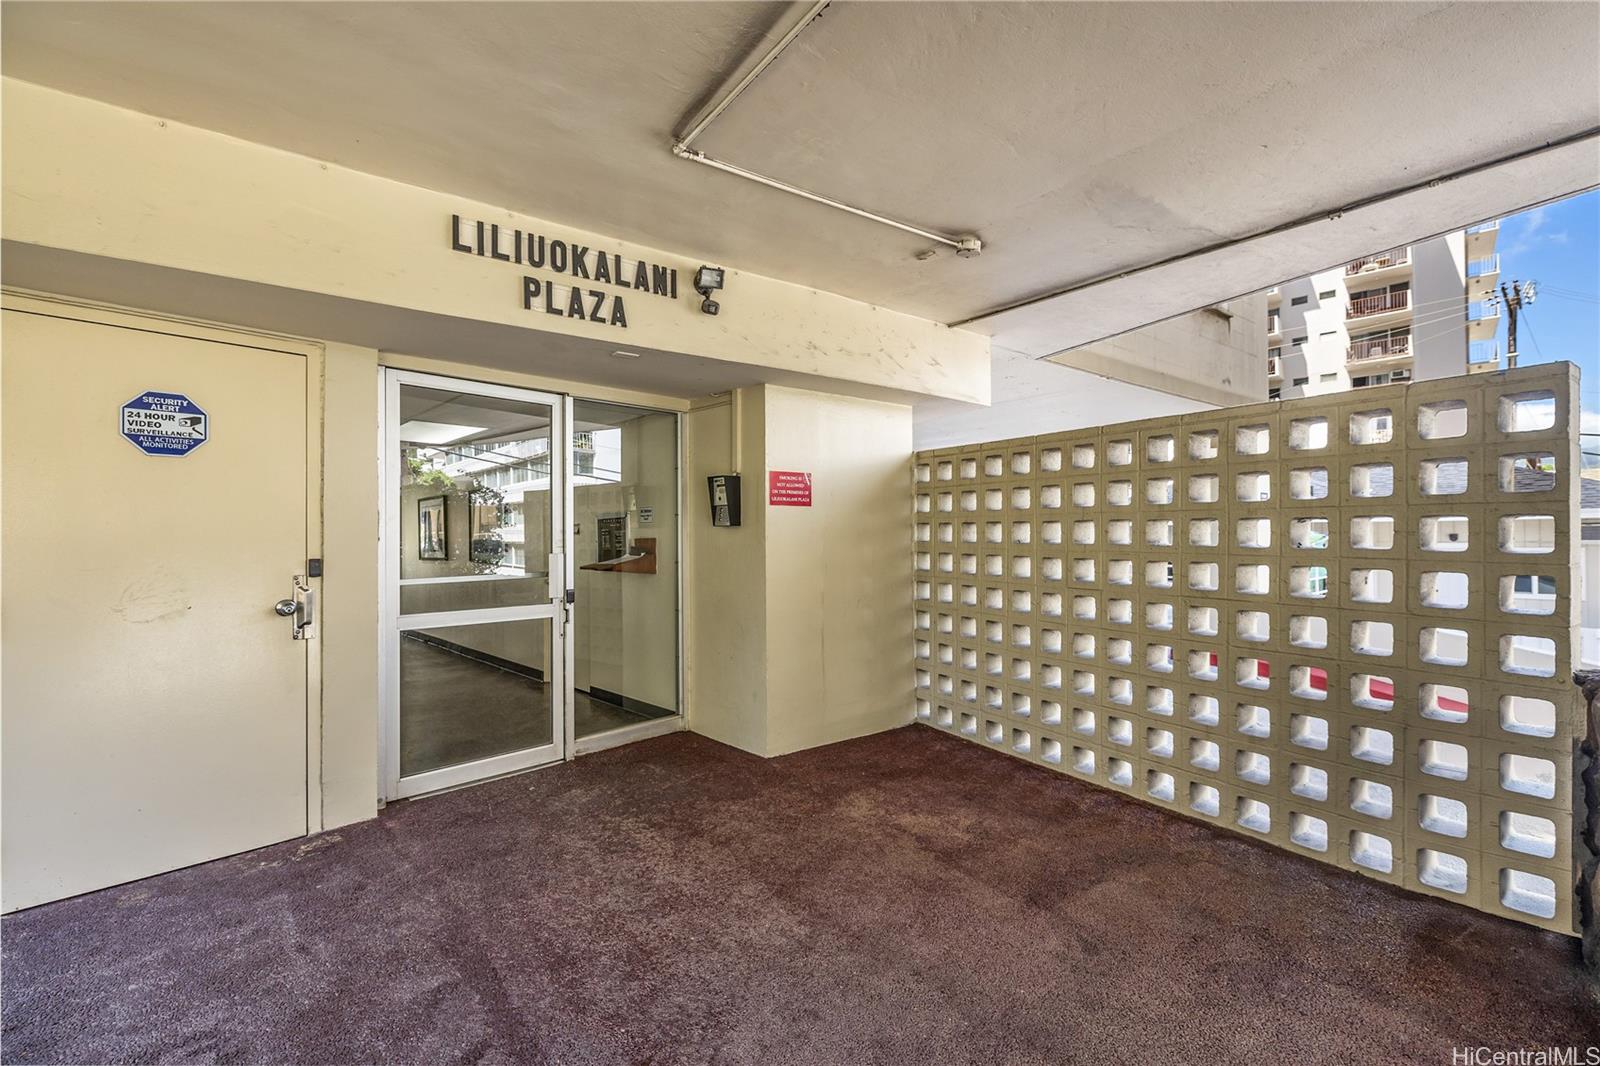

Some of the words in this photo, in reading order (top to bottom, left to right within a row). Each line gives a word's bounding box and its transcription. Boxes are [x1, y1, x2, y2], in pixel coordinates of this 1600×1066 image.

[452, 214, 677, 299] LILIUOKALANI
[523, 276, 628, 328] PLAZA
[142, 396, 189, 407] SECURITY
[150, 404, 180, 412] ALERT
[144, 412, 176, 421] HOUR
[127, 420, 162, 428] VIDEO
[127, 427, 194, 437] SURVEILLANCE
[154, 437, 194, 445] ACTIVITIES
